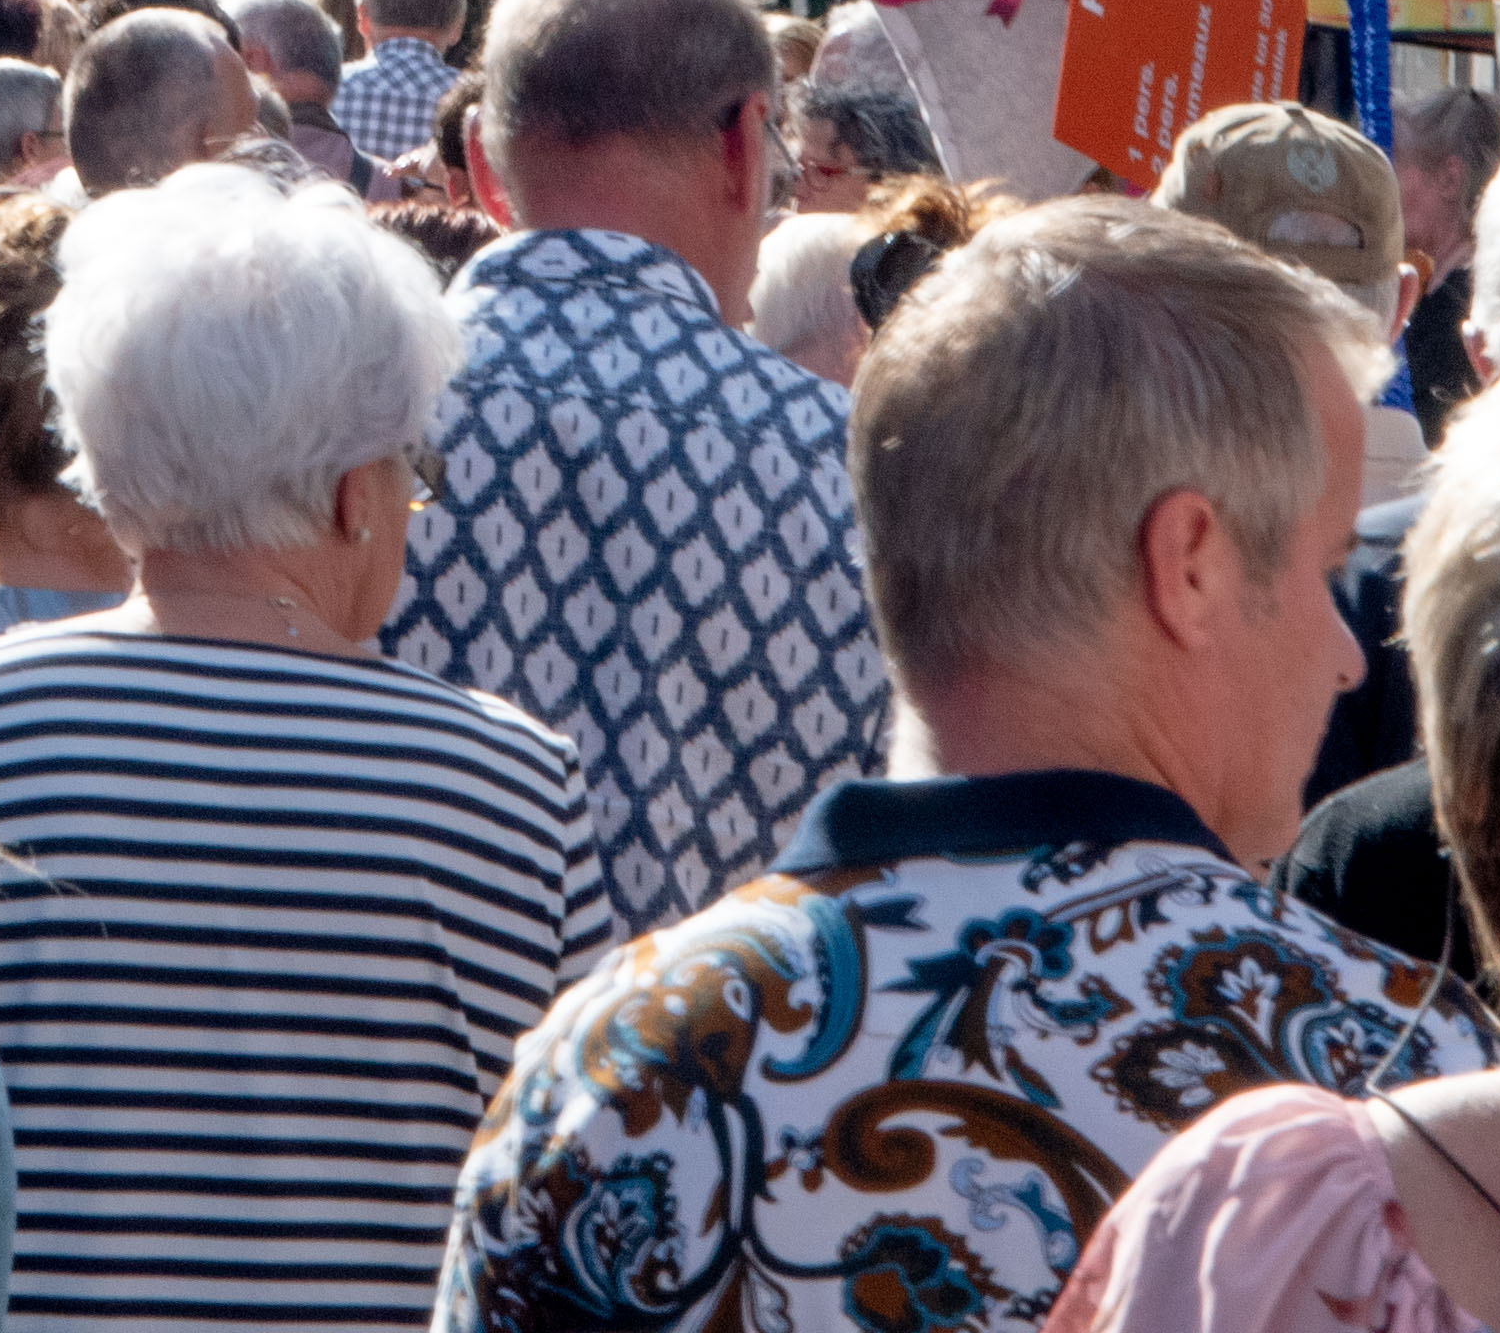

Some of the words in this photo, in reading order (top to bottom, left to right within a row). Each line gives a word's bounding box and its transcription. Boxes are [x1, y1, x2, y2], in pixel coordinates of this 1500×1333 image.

[1133, 61, 1155, 139] pers.
[1157, 73, 1179, 154] pers.
[1128, 147, 1144, 162] 1
